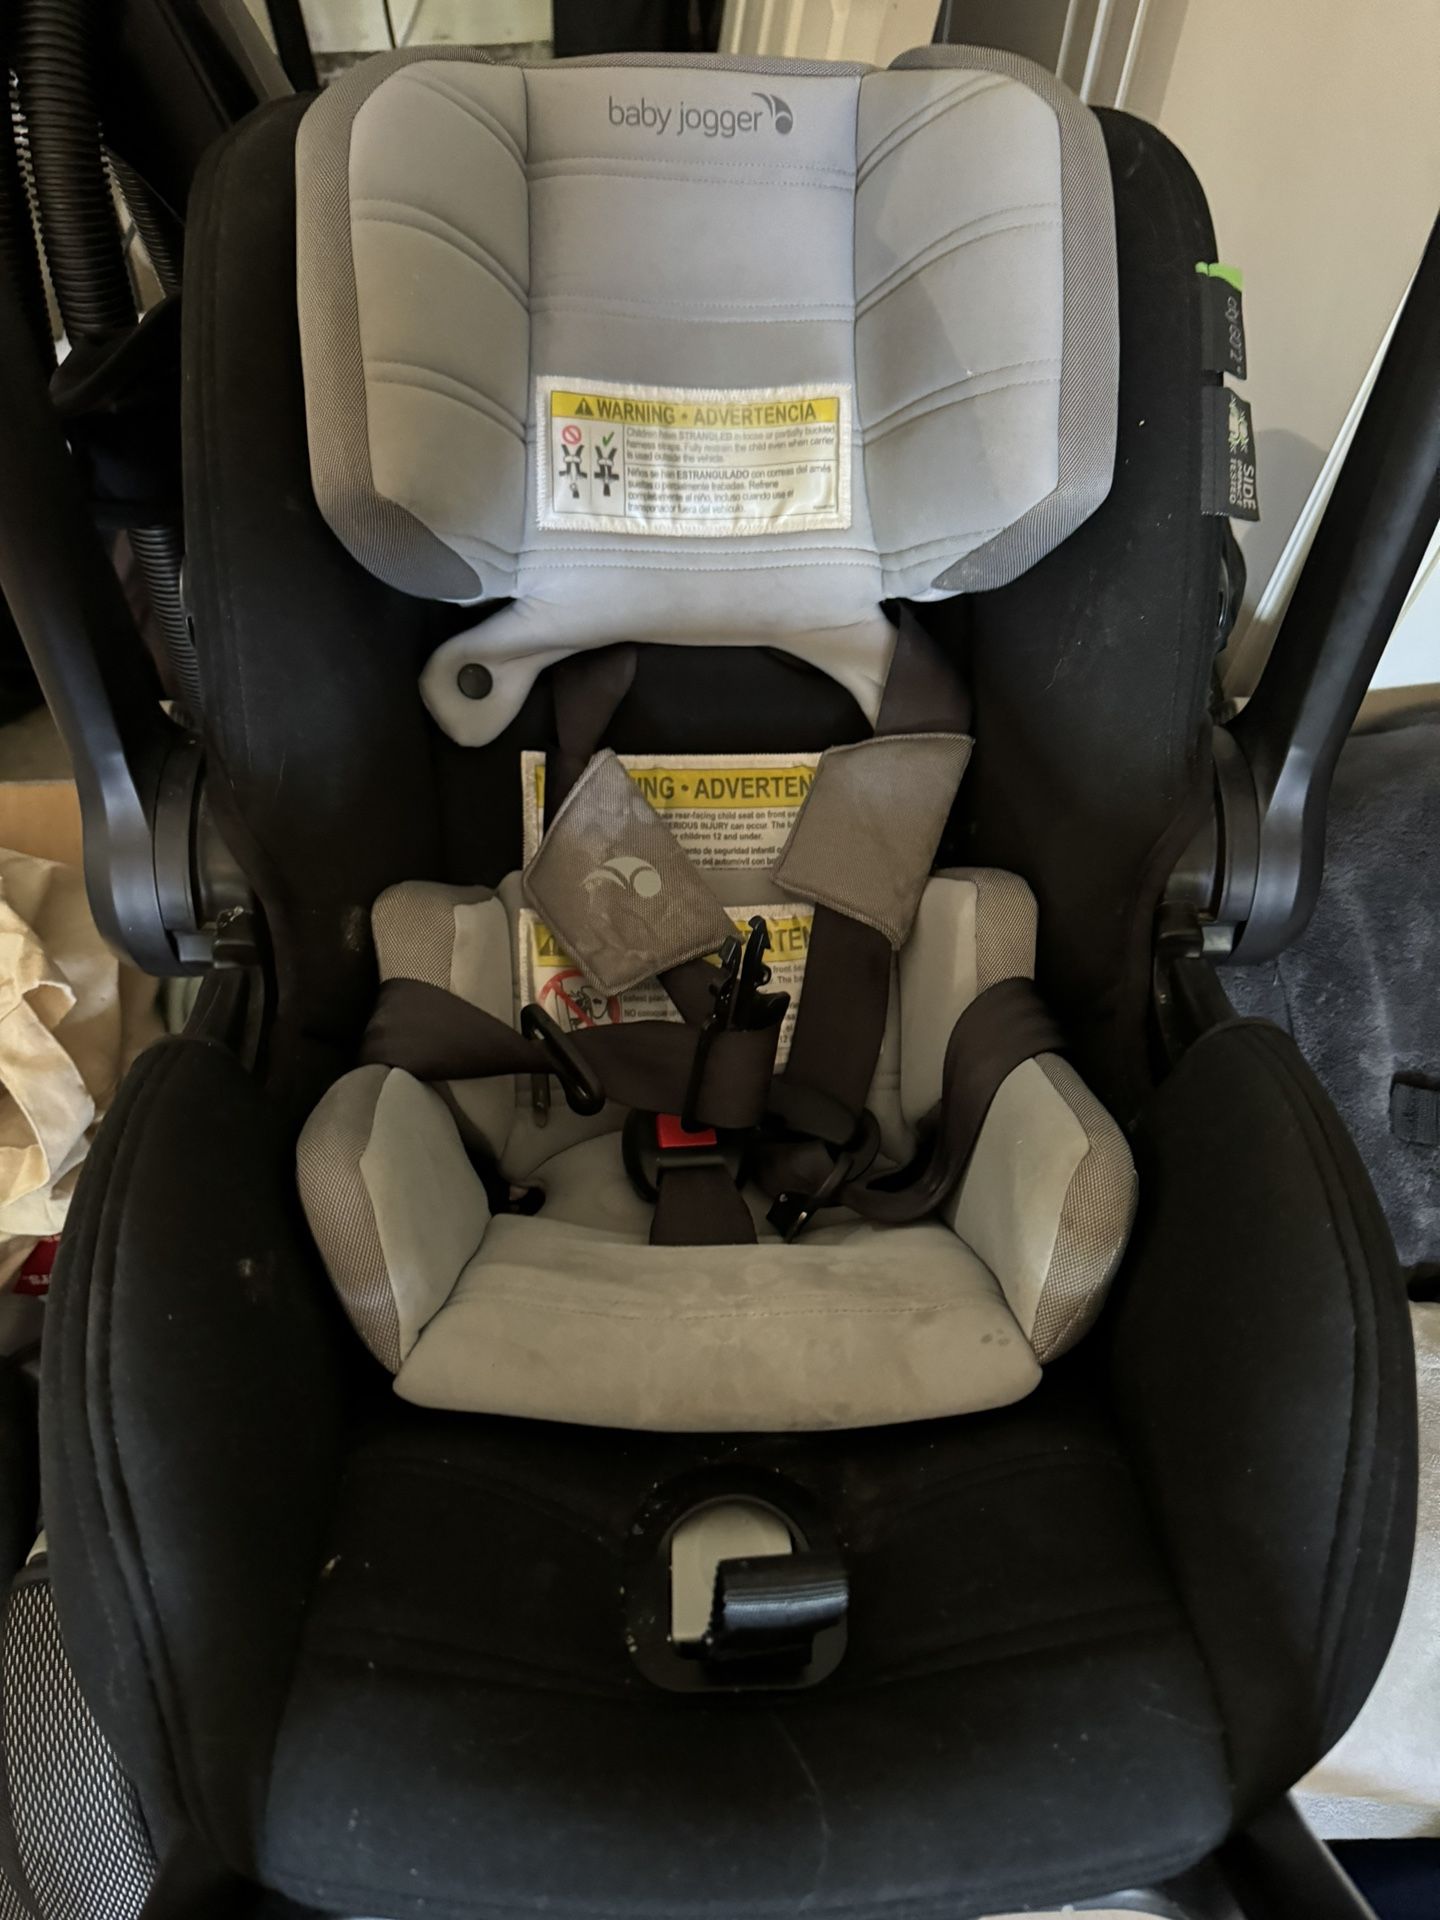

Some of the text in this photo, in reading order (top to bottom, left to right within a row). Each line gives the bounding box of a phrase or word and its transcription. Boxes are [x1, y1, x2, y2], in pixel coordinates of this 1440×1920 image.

[608, 96, 763, 138] baby jogger
[597, 399, 817, 426] WARNING ADVERTENCIA
[679, 431, 732, 441] STRANGLED
[774, 427, 803, 441] partially
[748, 442, 766, 452] child
[767, 443, 786, 451] even
[788, 439, 808, 448] when
[809, 437, 835, 446] carrier
[677, 469, 749, 480] ESTRANGULADO
[751, 470, 765, 478] con
[796, 464, 808, 474] del
[1229, 458, 1237, 504] TESTED
[1243, 464, 1257, 510] SIDE
[694, 774, 813, 799] ADVERTEN
[674, 811, 716, 821] rear-facing
[718, 811, 736, 819] child
[738, 811, 754, 819] seat
[767, 809, 785, 818] front
[668, 821, 699, 830] ERIOUS
[700, 821, 729, 830] INJURY
[731, 822, 744, 830] can
[771, 820, 785, 829] The
[680, 832, 711, 840] children
[713, 832, 721, 840] 12
[724, 832, 738, 840] and
[703, 847, 712, 855] de
[714, 847, 749, 856] seguridad
[751, 845, 776, 854] infantil
[777, 976, 791, 984] The
